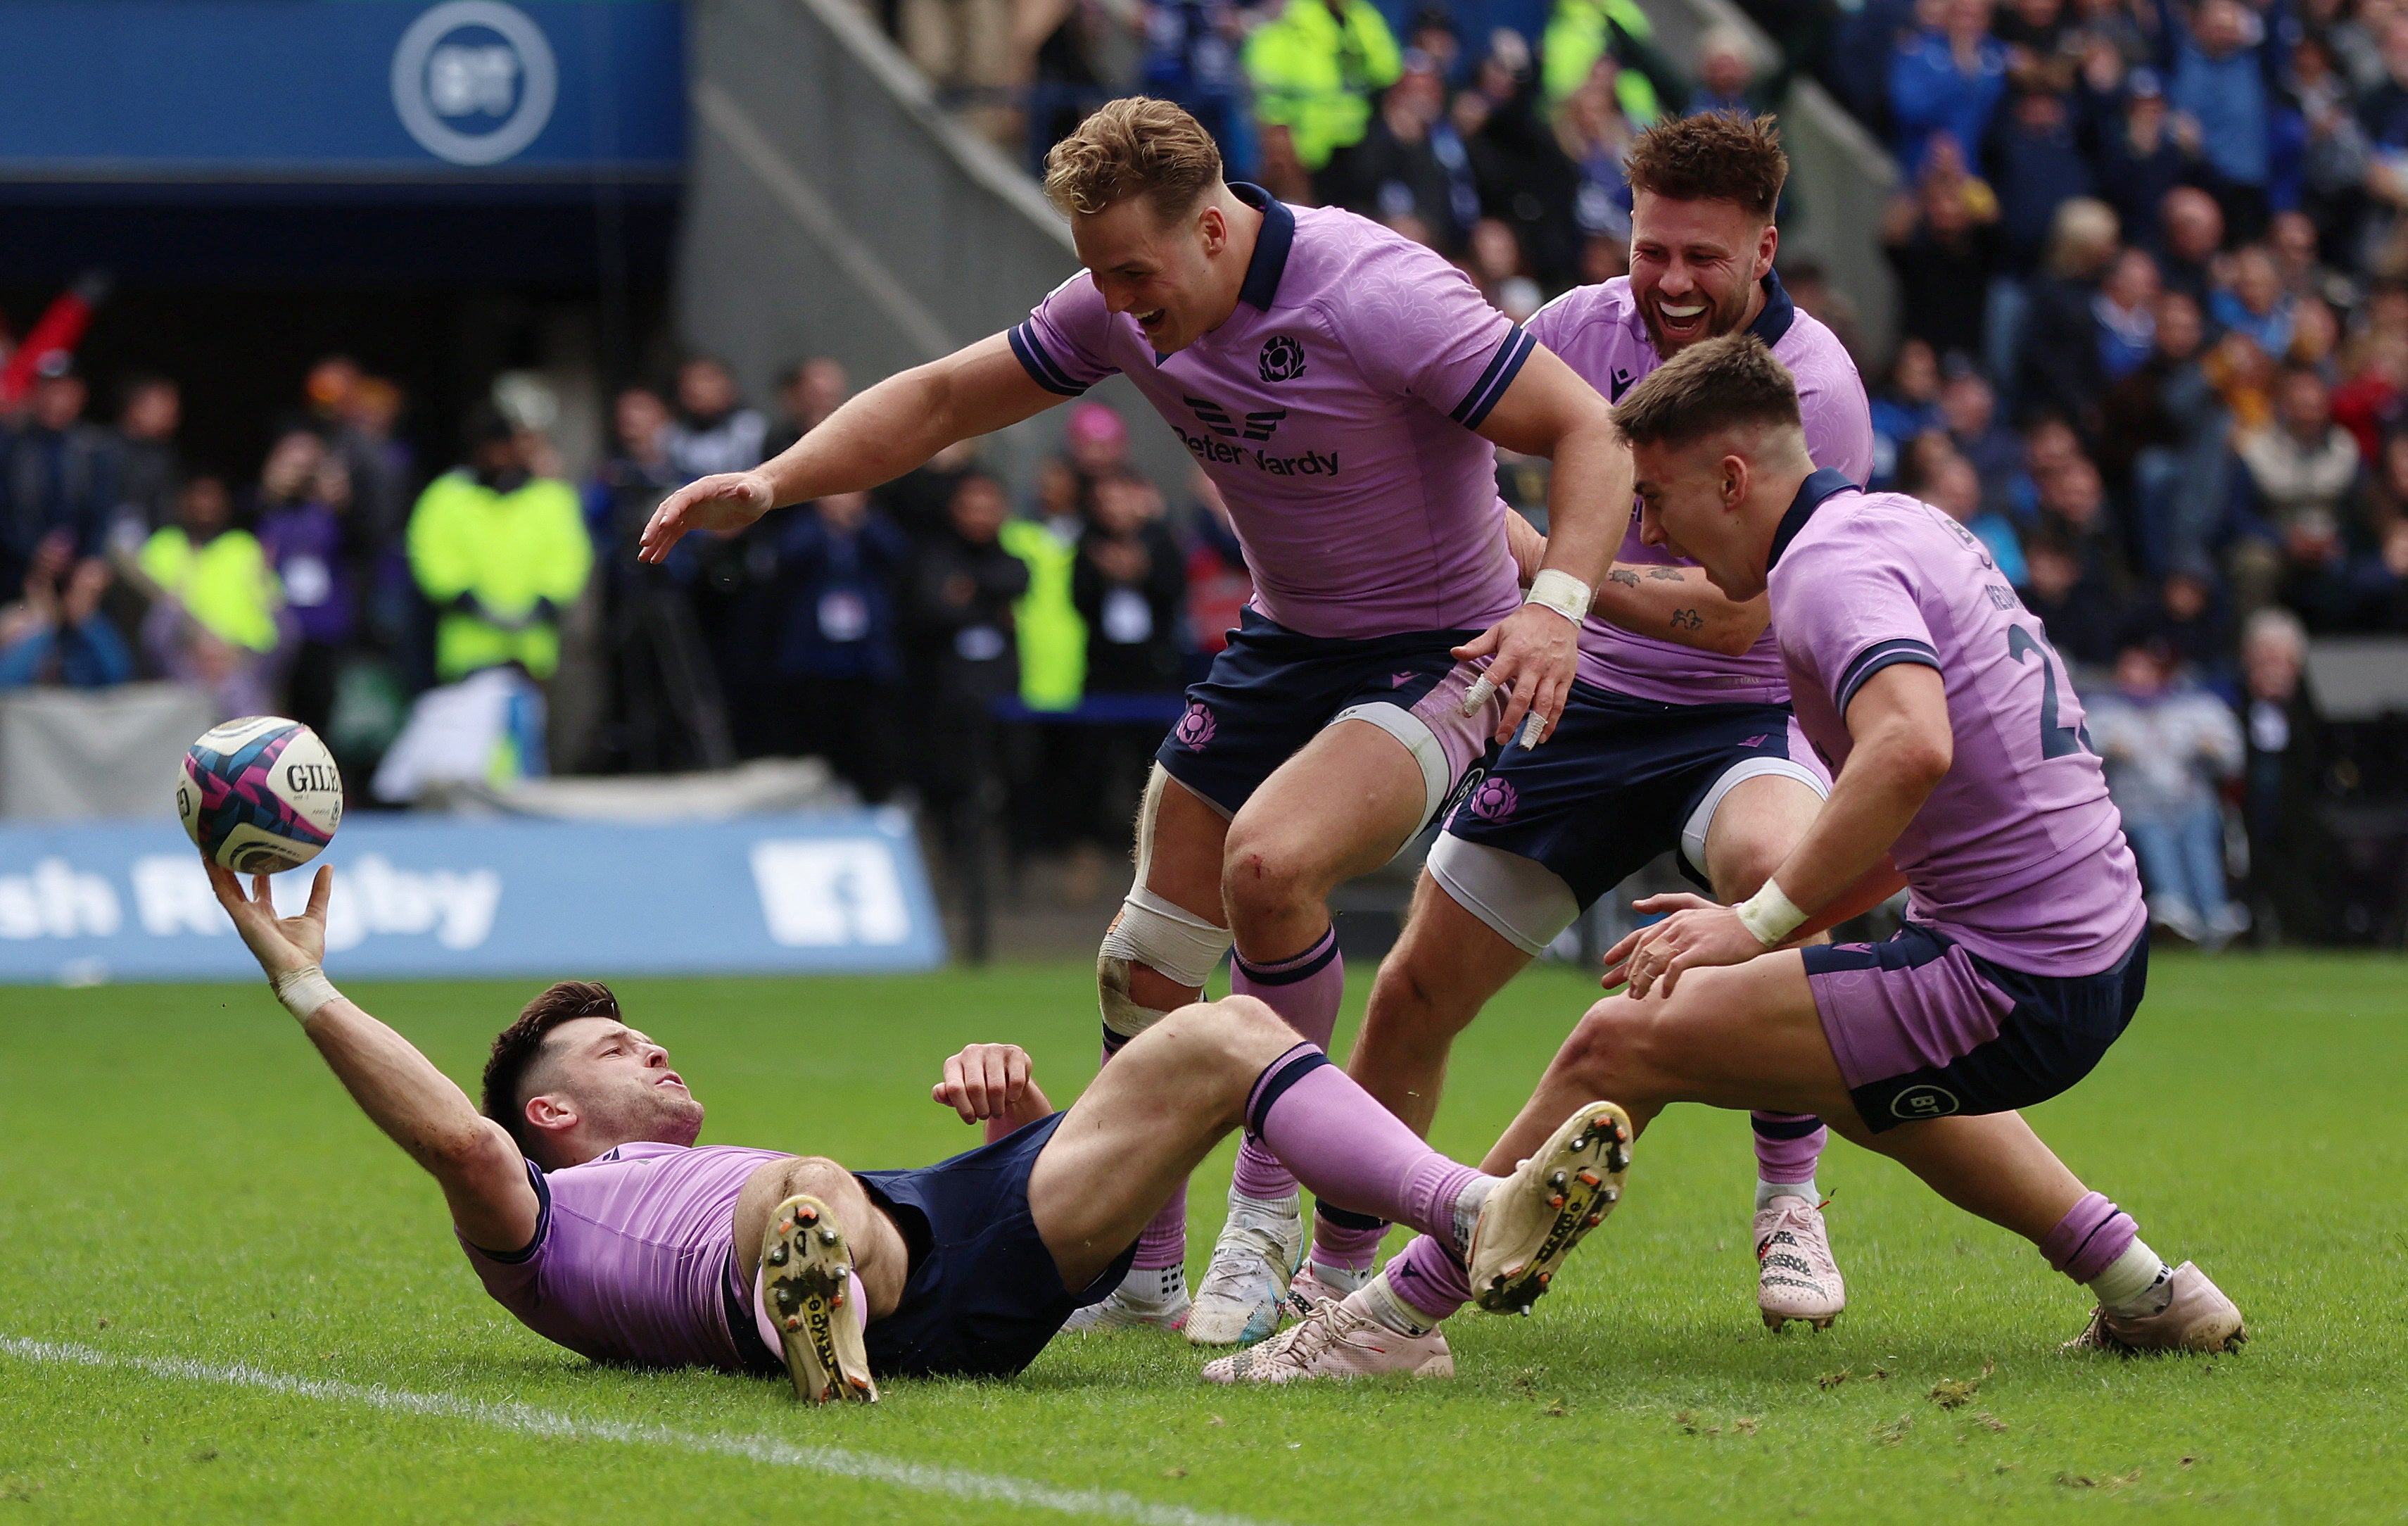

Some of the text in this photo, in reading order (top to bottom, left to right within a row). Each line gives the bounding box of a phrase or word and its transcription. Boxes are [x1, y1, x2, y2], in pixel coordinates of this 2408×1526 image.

[429, 44, 522, 117] BT
[2008, 622, 2095, 762] 2
[1910, 1095, 1940, 1113] BT
